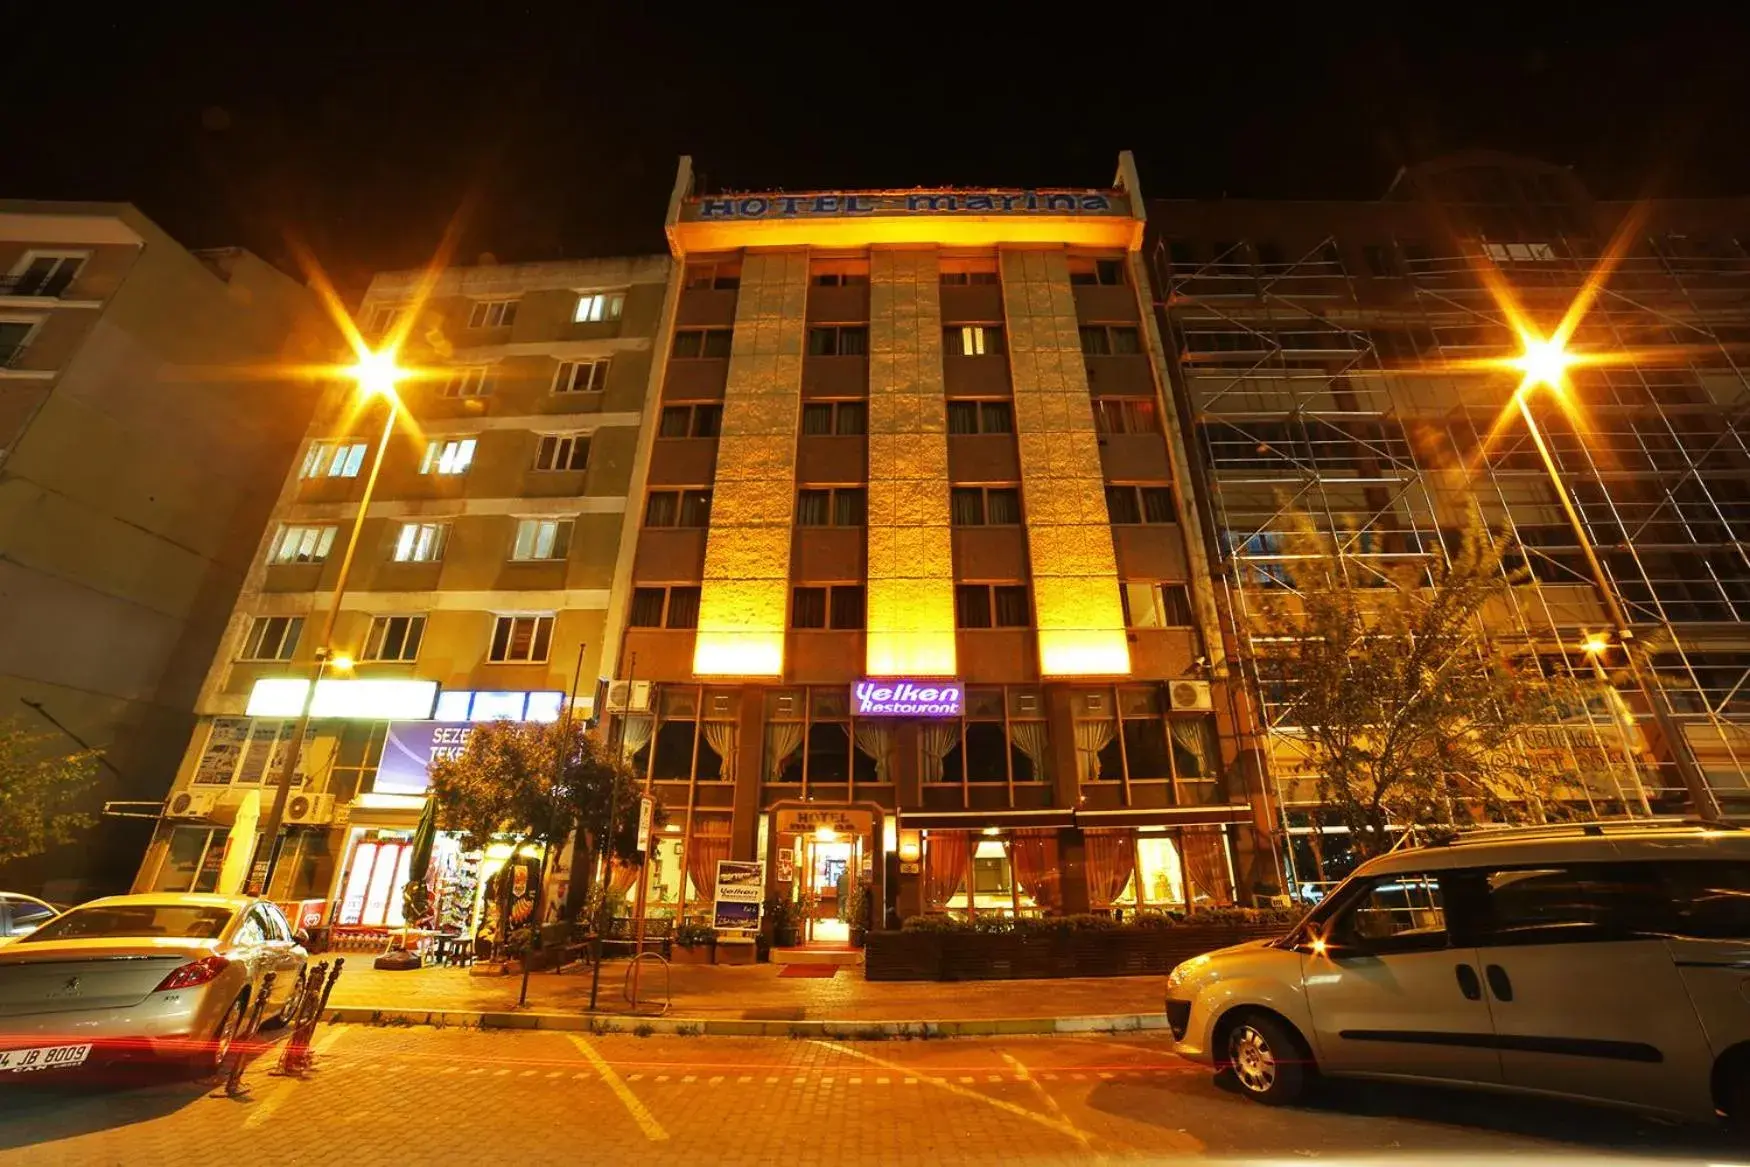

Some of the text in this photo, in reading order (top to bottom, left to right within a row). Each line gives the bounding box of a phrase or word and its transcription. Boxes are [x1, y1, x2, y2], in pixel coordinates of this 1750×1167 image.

[702, 191, 1111, 216] HOTEL marina
[856, 682, 959, 702] Yelken
[860, 701, 959, 713] Restaurant
[432, 727, 474, 744] SEZE
[797, 811, 850, 823] HOTEL
[0, 1052, 10, 1067] 4
[17, 1049, 41, 1066] JB
[44, 1045, 87, 1063] 8009
